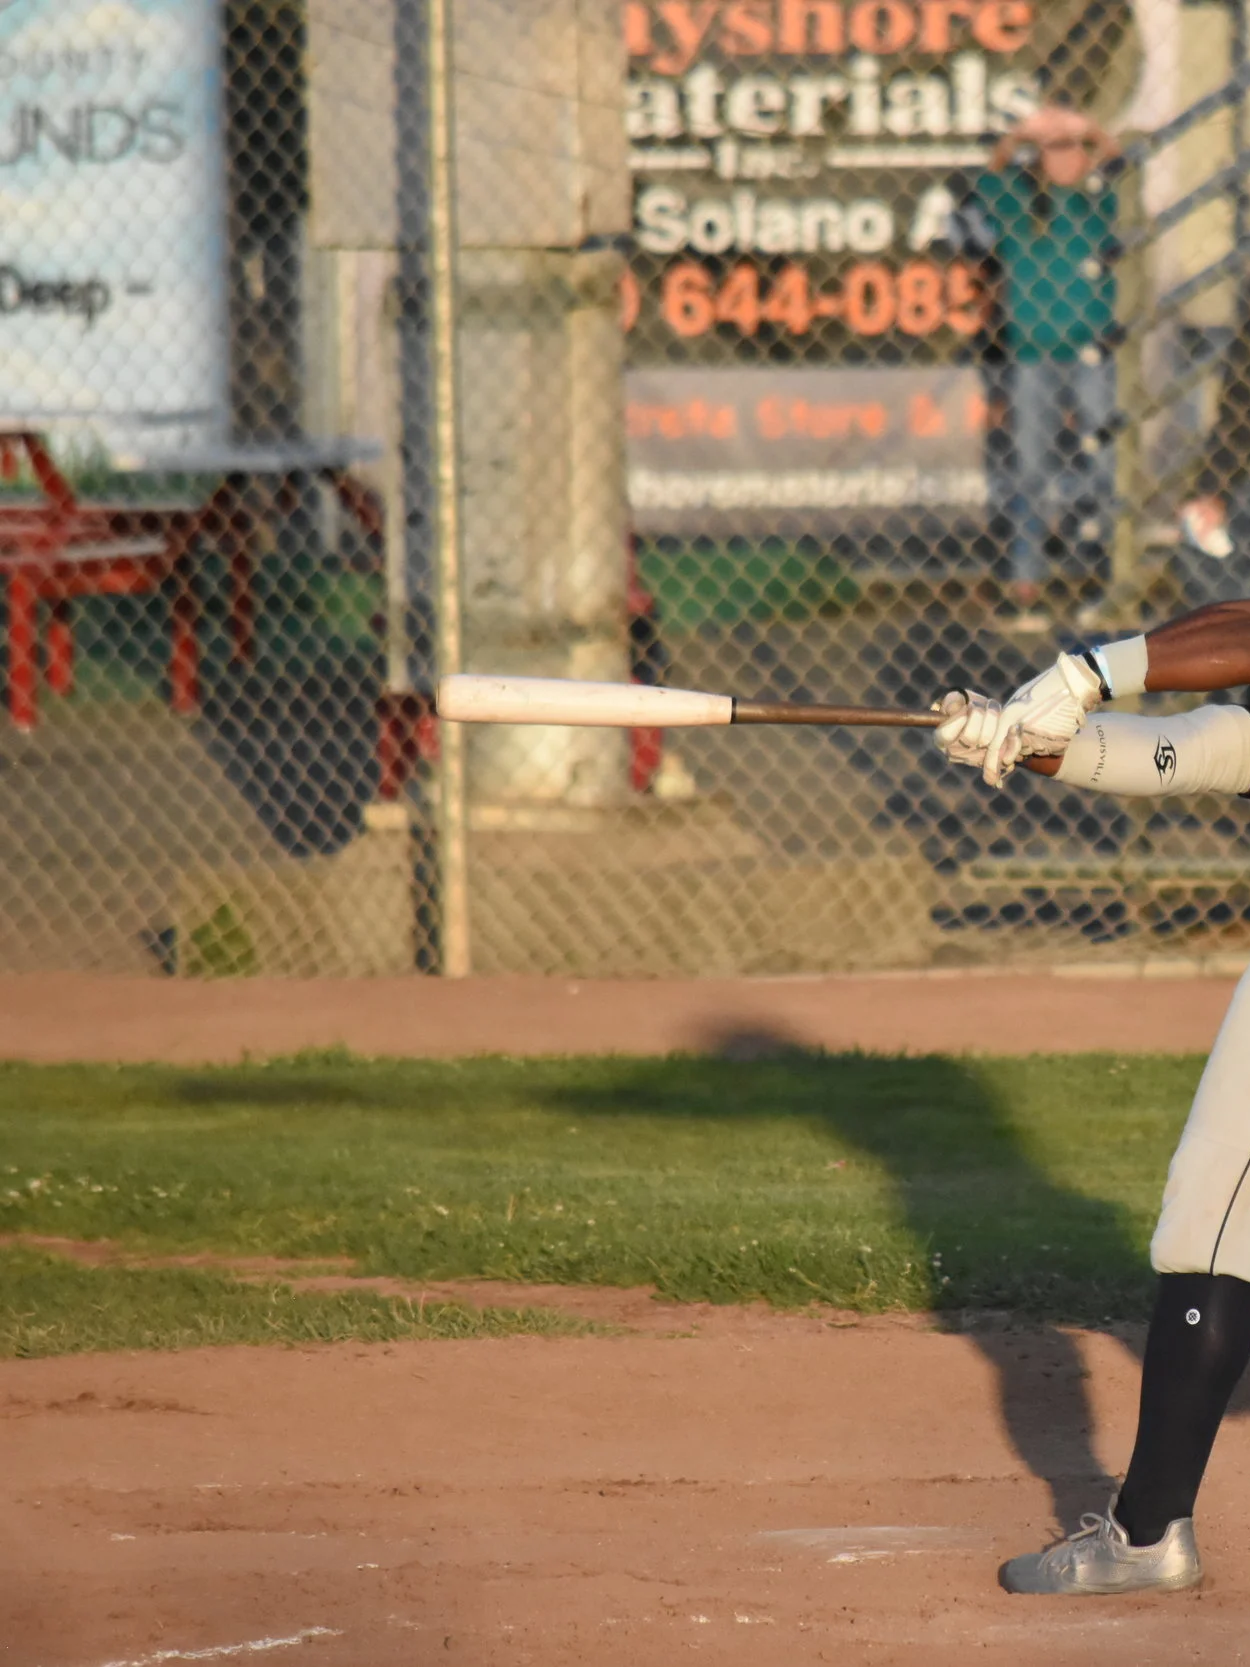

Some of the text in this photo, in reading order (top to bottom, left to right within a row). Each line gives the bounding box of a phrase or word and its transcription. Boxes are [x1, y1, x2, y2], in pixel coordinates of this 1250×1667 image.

[625, 52, 1042, 138] aterials
[636, 187, 894, 254] Solano
[1090, 724, 1107, 783] LOUISVILLE
